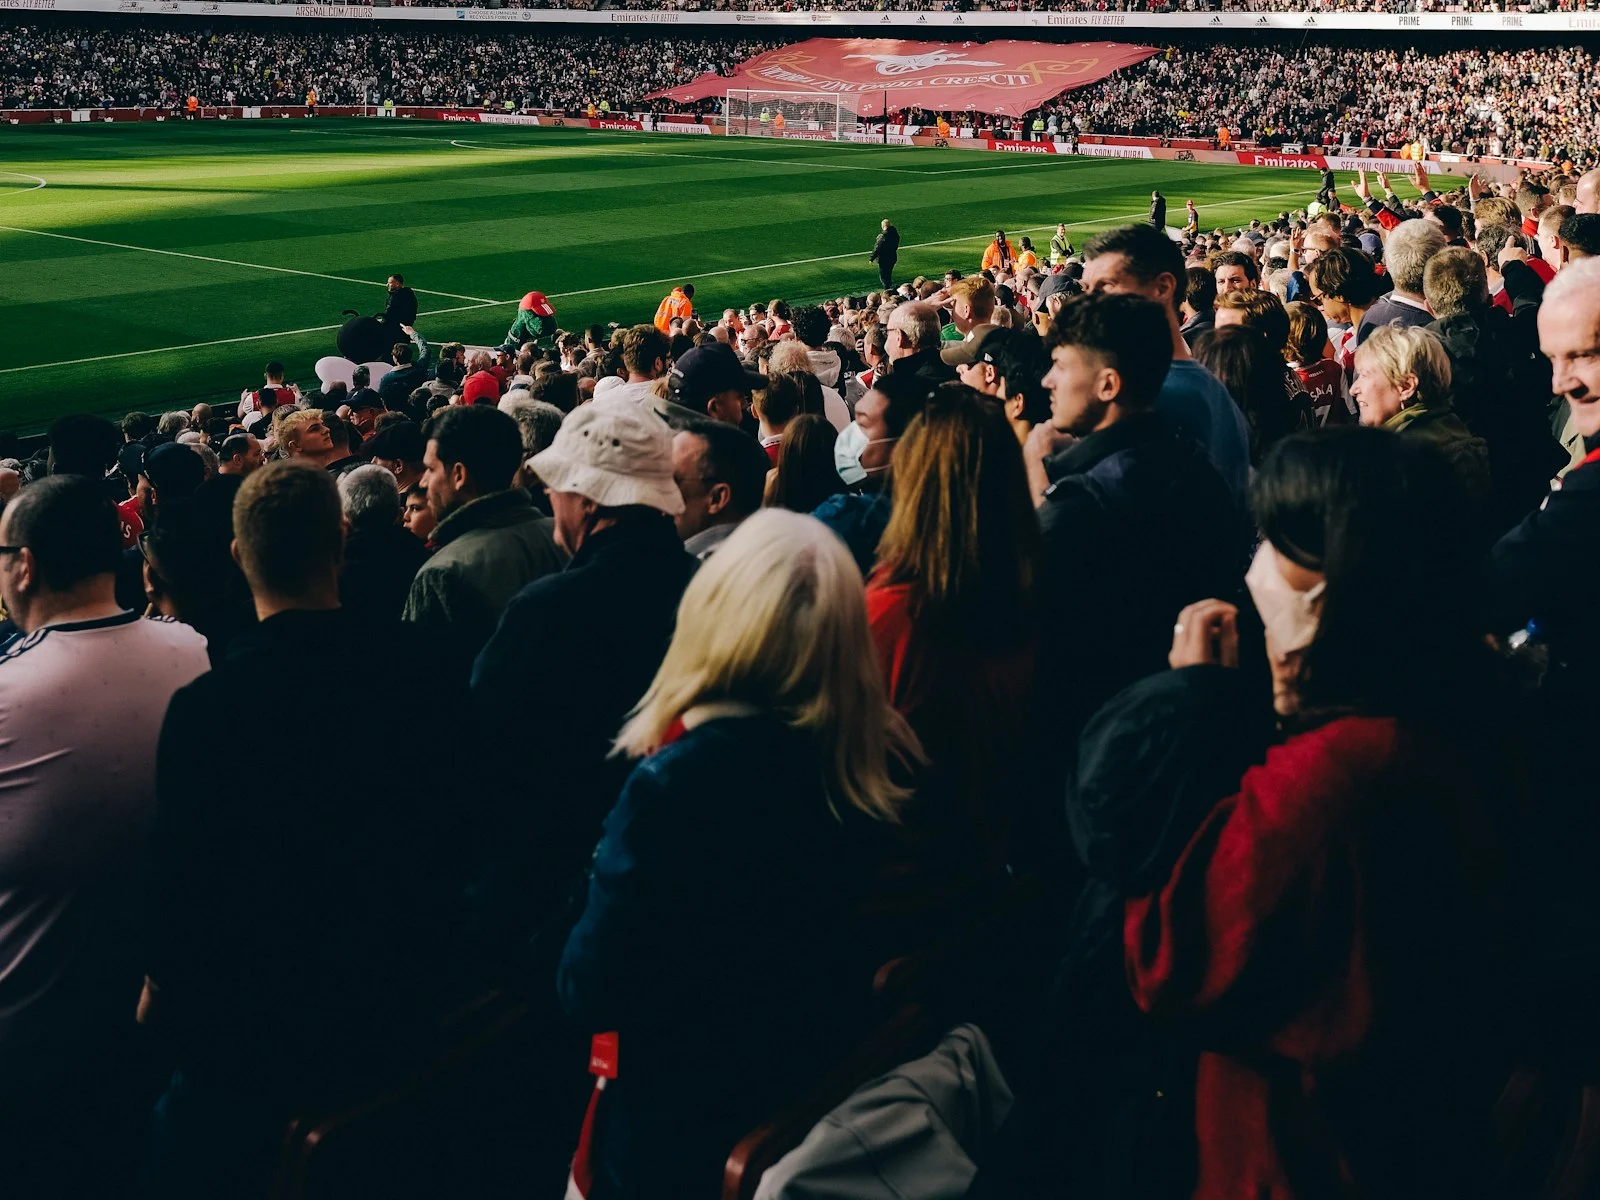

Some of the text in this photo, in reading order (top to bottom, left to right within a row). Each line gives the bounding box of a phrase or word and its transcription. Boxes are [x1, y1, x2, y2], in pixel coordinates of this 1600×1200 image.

[23, 0, 33, 8] FLY
[34, 0, 56, 9] BETTER
[295, 6, 373, 18] ARSENAL.COM/TOURS
[611, 13, 679, 23] Emirates FLY BETTER
[1047, 14, 1125, 25] Emirates FLY BETTER
[1398, 16, 1420, 26] PRIME
[1451, 16, 1473, 26] PRIME
[1502, 16, 1523, 27] PRIME
[929, 73, 1030, 86] CRESCIT
[443, 113, 476, 122] Emirates
[599, 121, 637, 130] Emirates
[995, 142, 1047, 153] Emirates
[1094, 148, 1111, 157] SOON
[1113, 149, 1121, 157] IN
[1123, 149, 1144, 158] DUBAI
[1254, 155, 1317, 169] Emirates
[1340, 161, 1354, 171] SEE
[1374, 162, 1394, 173] SOON
[1398, 163, 1406, 173] IN
